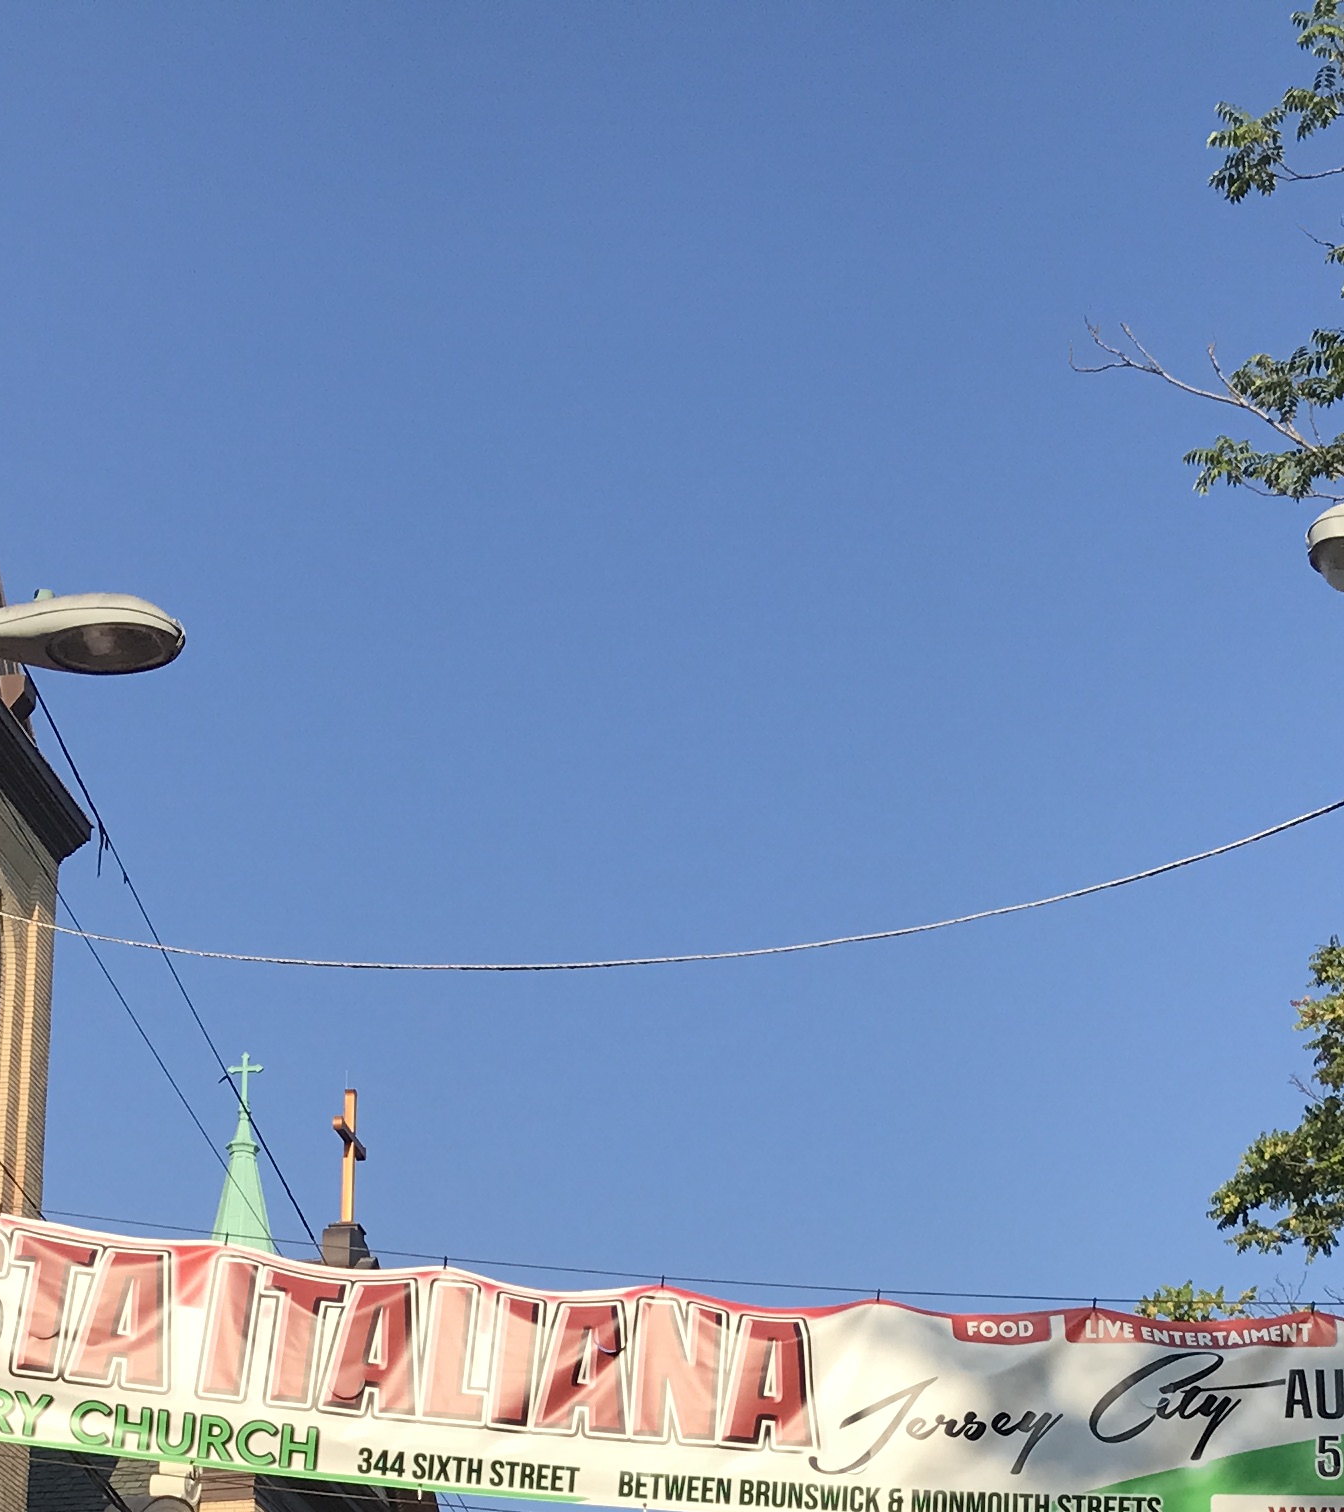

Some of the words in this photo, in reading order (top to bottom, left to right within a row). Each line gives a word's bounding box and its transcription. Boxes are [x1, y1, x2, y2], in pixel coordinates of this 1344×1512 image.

[197, 1253, 820, 1453] ITALIANA
[966, 1319, 1034, 1339] FOOD
[1084, 1318, 1134, 1341] LIVE
[1140, 1322, 1312, 1347] ENTERTAIMENT
[68, 1400, 320, 1472] CHURCH
[808, 1377, 1063, 1475] Jersey
[1089, 1351, 1286, 1461] City
[356, 1447, 406, 1478] 344
[411, 1449, 483, 1484] SIXTH
[489, 1458, 581, 1494] STREET
[618, 1472, 732, 1506] BETWEEN
